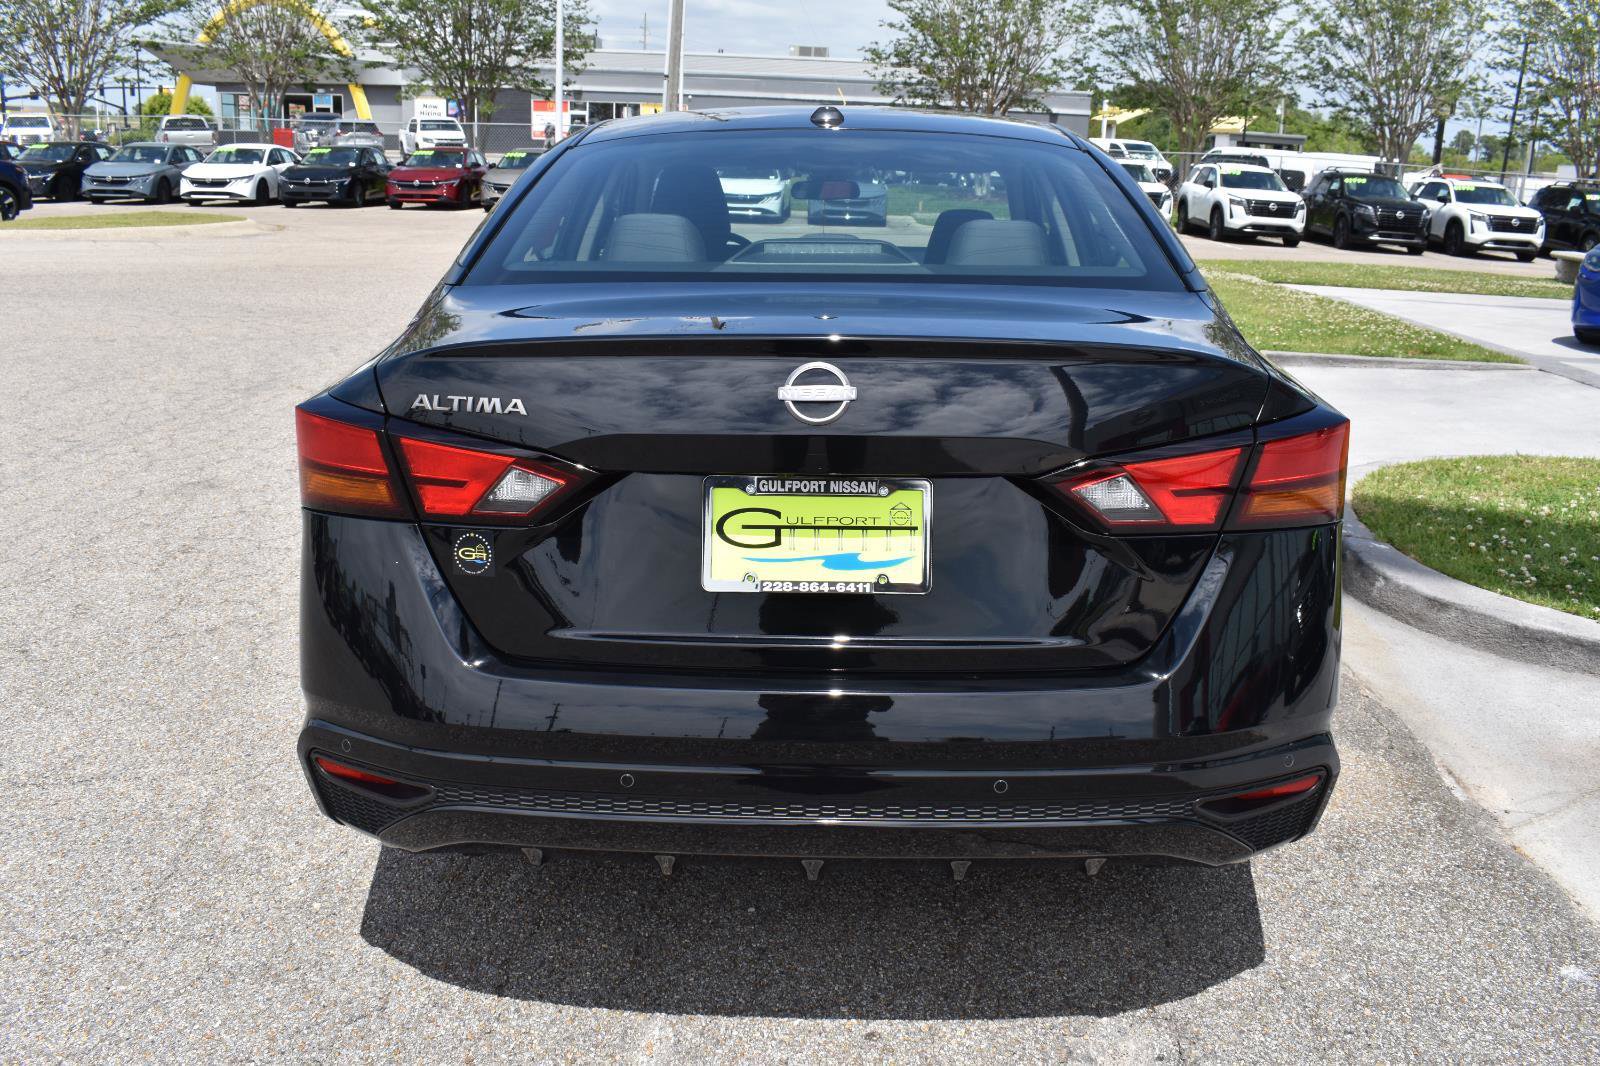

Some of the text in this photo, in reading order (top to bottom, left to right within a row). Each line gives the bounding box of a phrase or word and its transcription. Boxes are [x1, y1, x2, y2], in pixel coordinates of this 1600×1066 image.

[779, 388, 857, 400] NISSAN
[410, 393, 528, 416] ALTIMA
[759, 480, 877, 493] GULFPORT NISSAN
[762, 582, 871, 593] 228-864-6411
